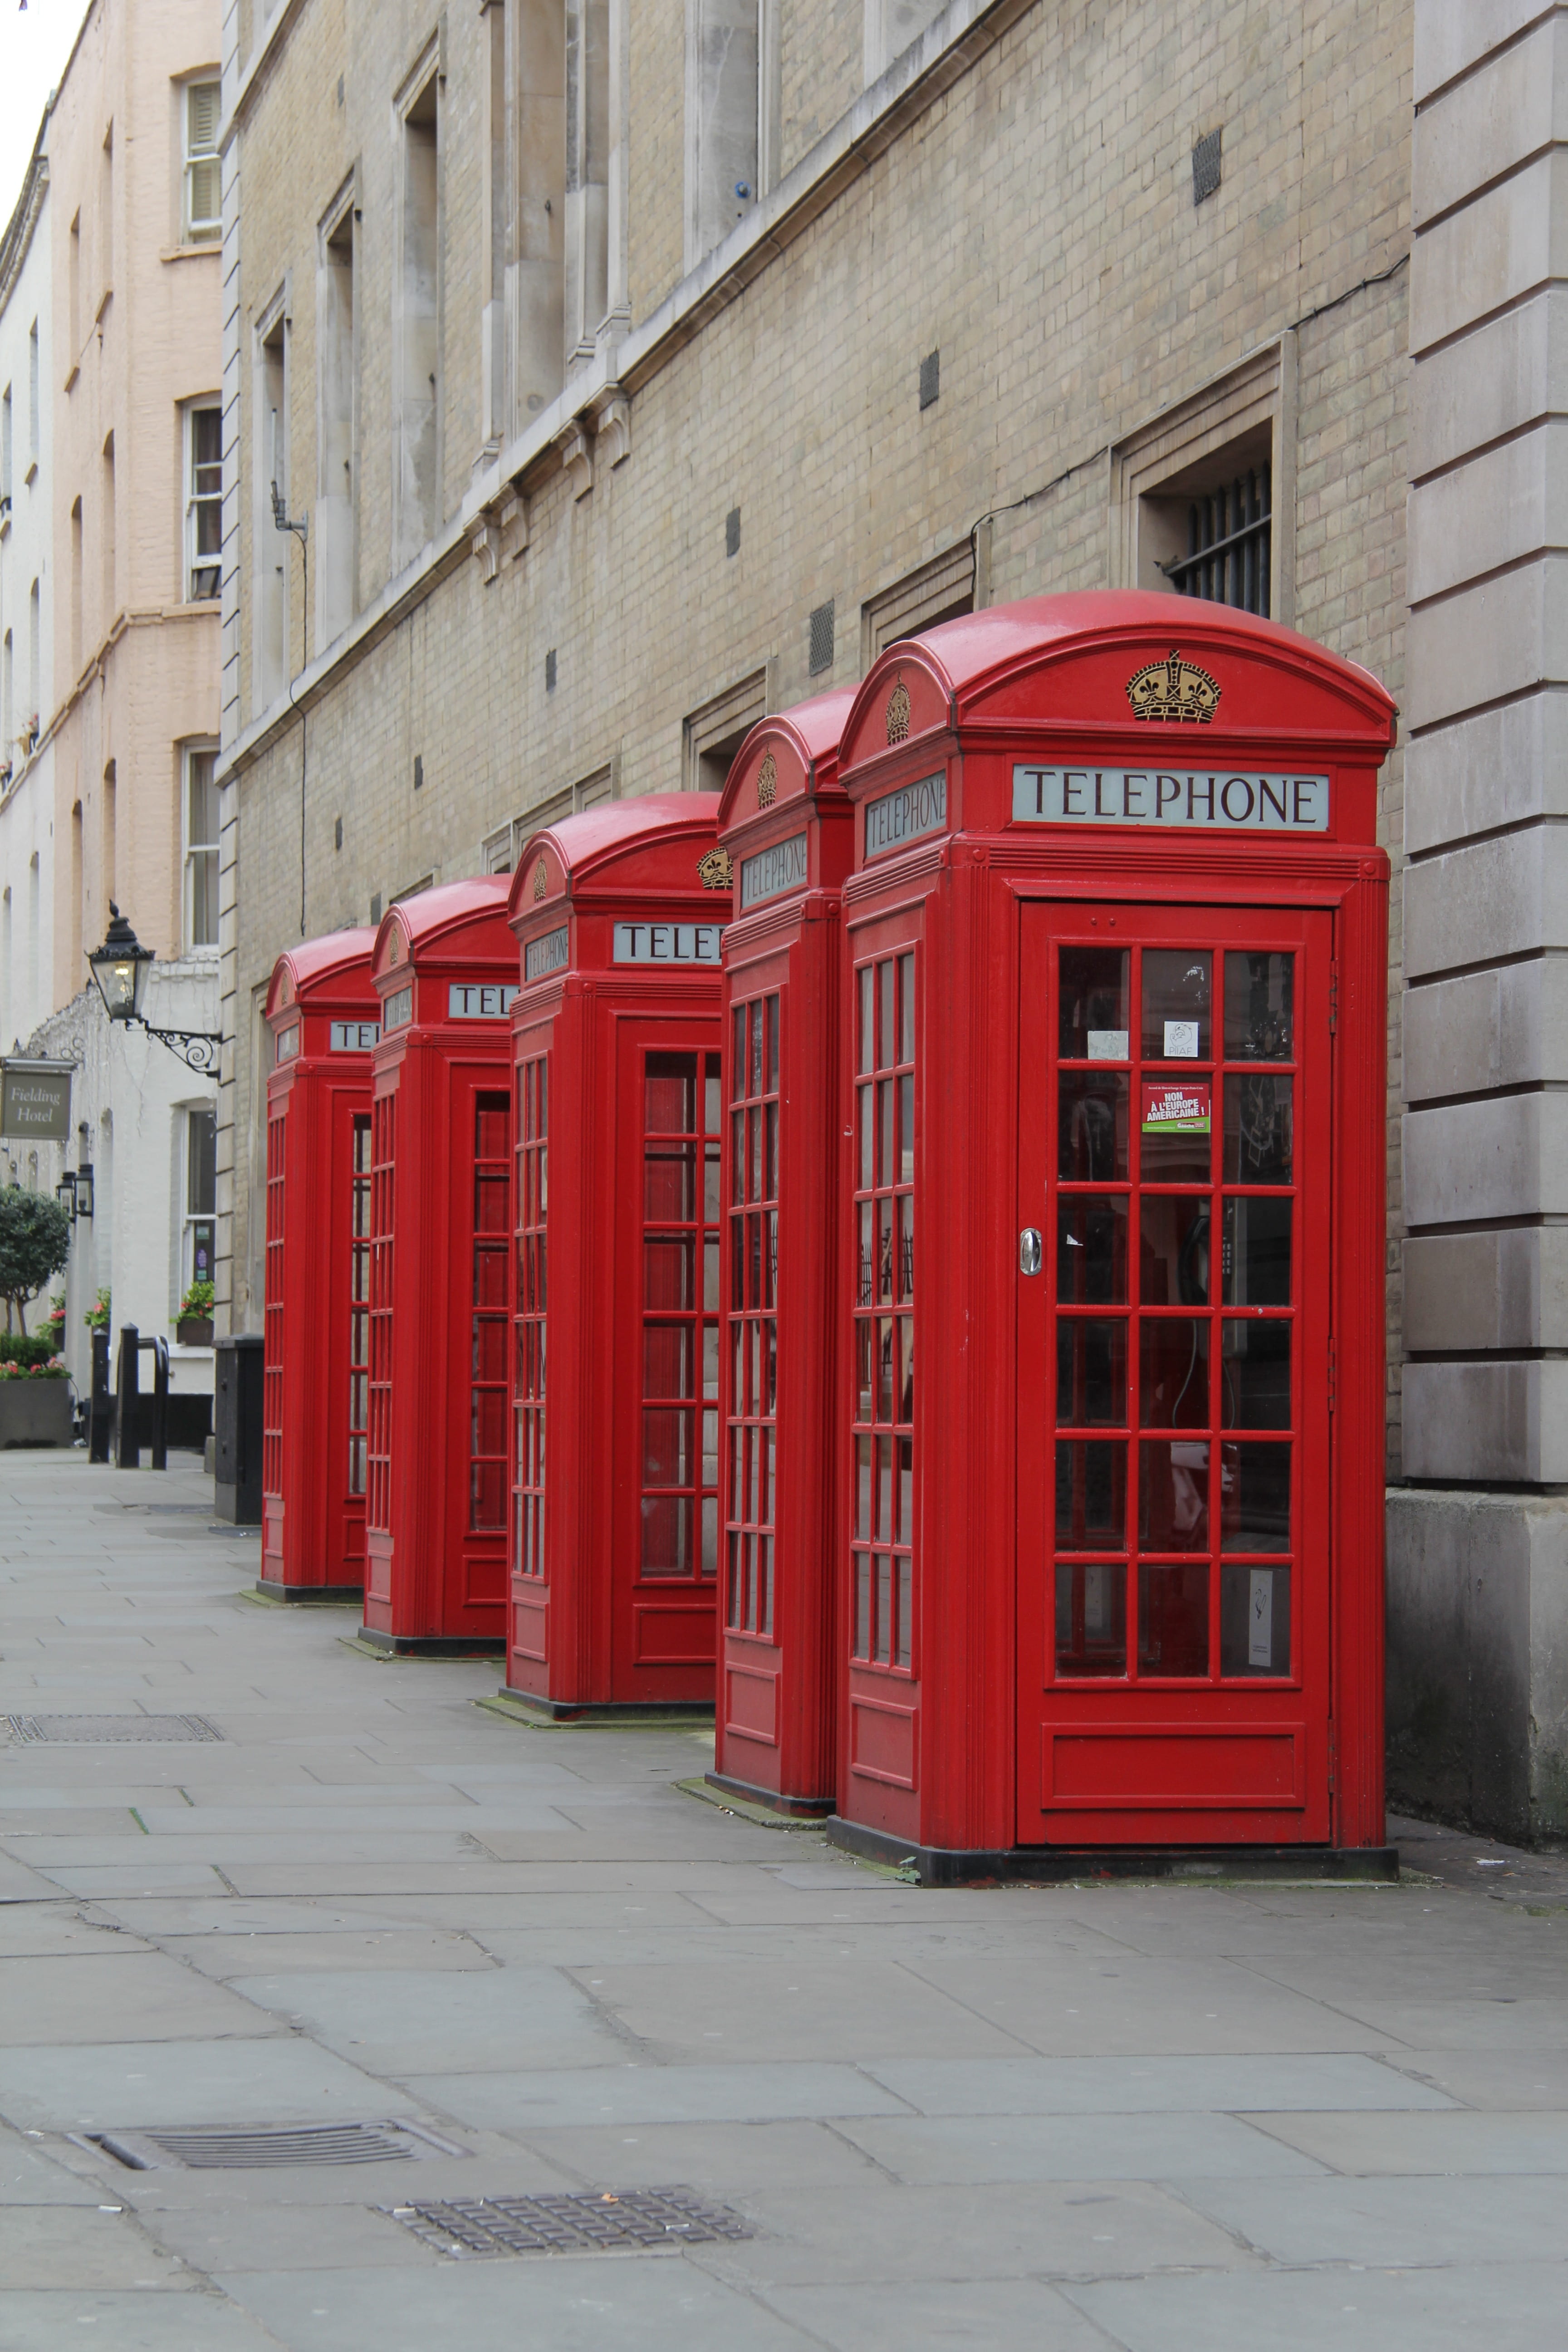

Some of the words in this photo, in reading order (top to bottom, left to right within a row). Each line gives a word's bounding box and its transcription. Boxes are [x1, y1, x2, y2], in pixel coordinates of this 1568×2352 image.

[1024, 771, 1317, 823] TELEPHONE
[870, 779, 945, 848] TELEPHONE
[745, 838, 806, 900] TELEPHONE
[456, 987, 520, 1014] TEL
[11, 1087, 60, 1106] Fielding
[1151, 1101, 1157, 1112] À
[1159, 1098, 1199, 1111] L'EUROPE
[1164, 1092, 1183, 1102] NON
[18, 1107, 53, 1122] Hotel
